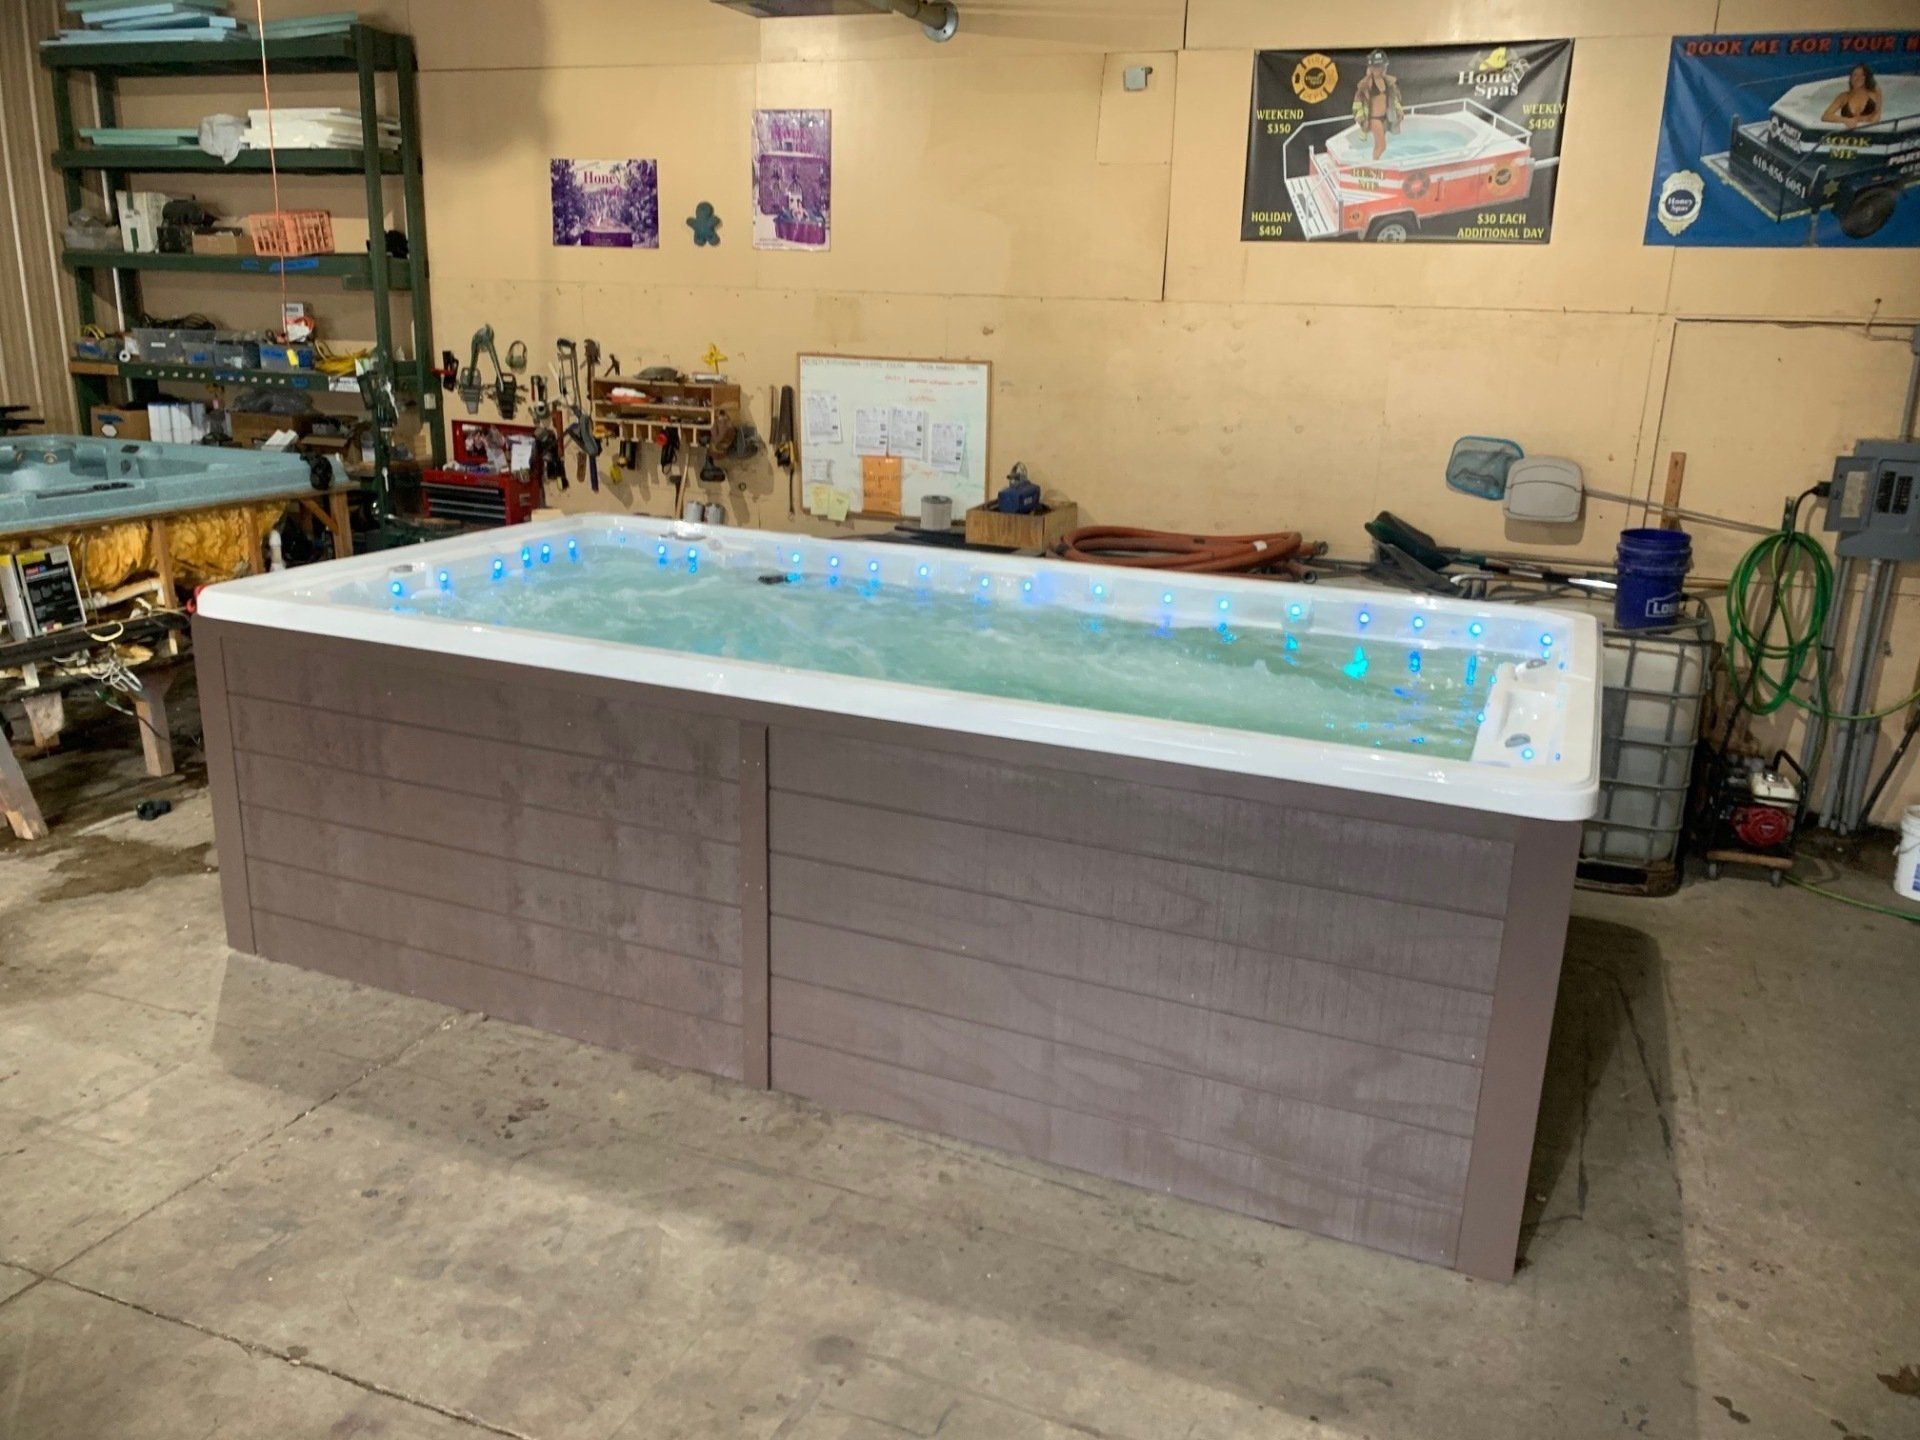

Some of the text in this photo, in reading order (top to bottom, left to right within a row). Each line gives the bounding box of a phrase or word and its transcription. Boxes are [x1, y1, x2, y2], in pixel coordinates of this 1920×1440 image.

[1685, 40, 1742, 56] BOOK
[1750, 39, 1779, 54] ME
[1788, 37, 1832, 53] FOR
[1841, 35, 1896, 52] YOUR
[1474, 82, 1519, 100] Spas
[1256, 109, 1304, 120] WEEKEND
[1522, 103, 1565, 115] WEEKLY
[1267, 123, 1292, 134] $350
[1529, 118, 1556, 130] $450
[583, 166, 623, 184] Honey
[1251, 211, 1293, 223] HOLIDAY
[1477, 213, 1527, 225] $30 EACH
[1259, 225, 1282, 237] $450
[1457, 227, 1545, 239] ADDITIONAL DAY
